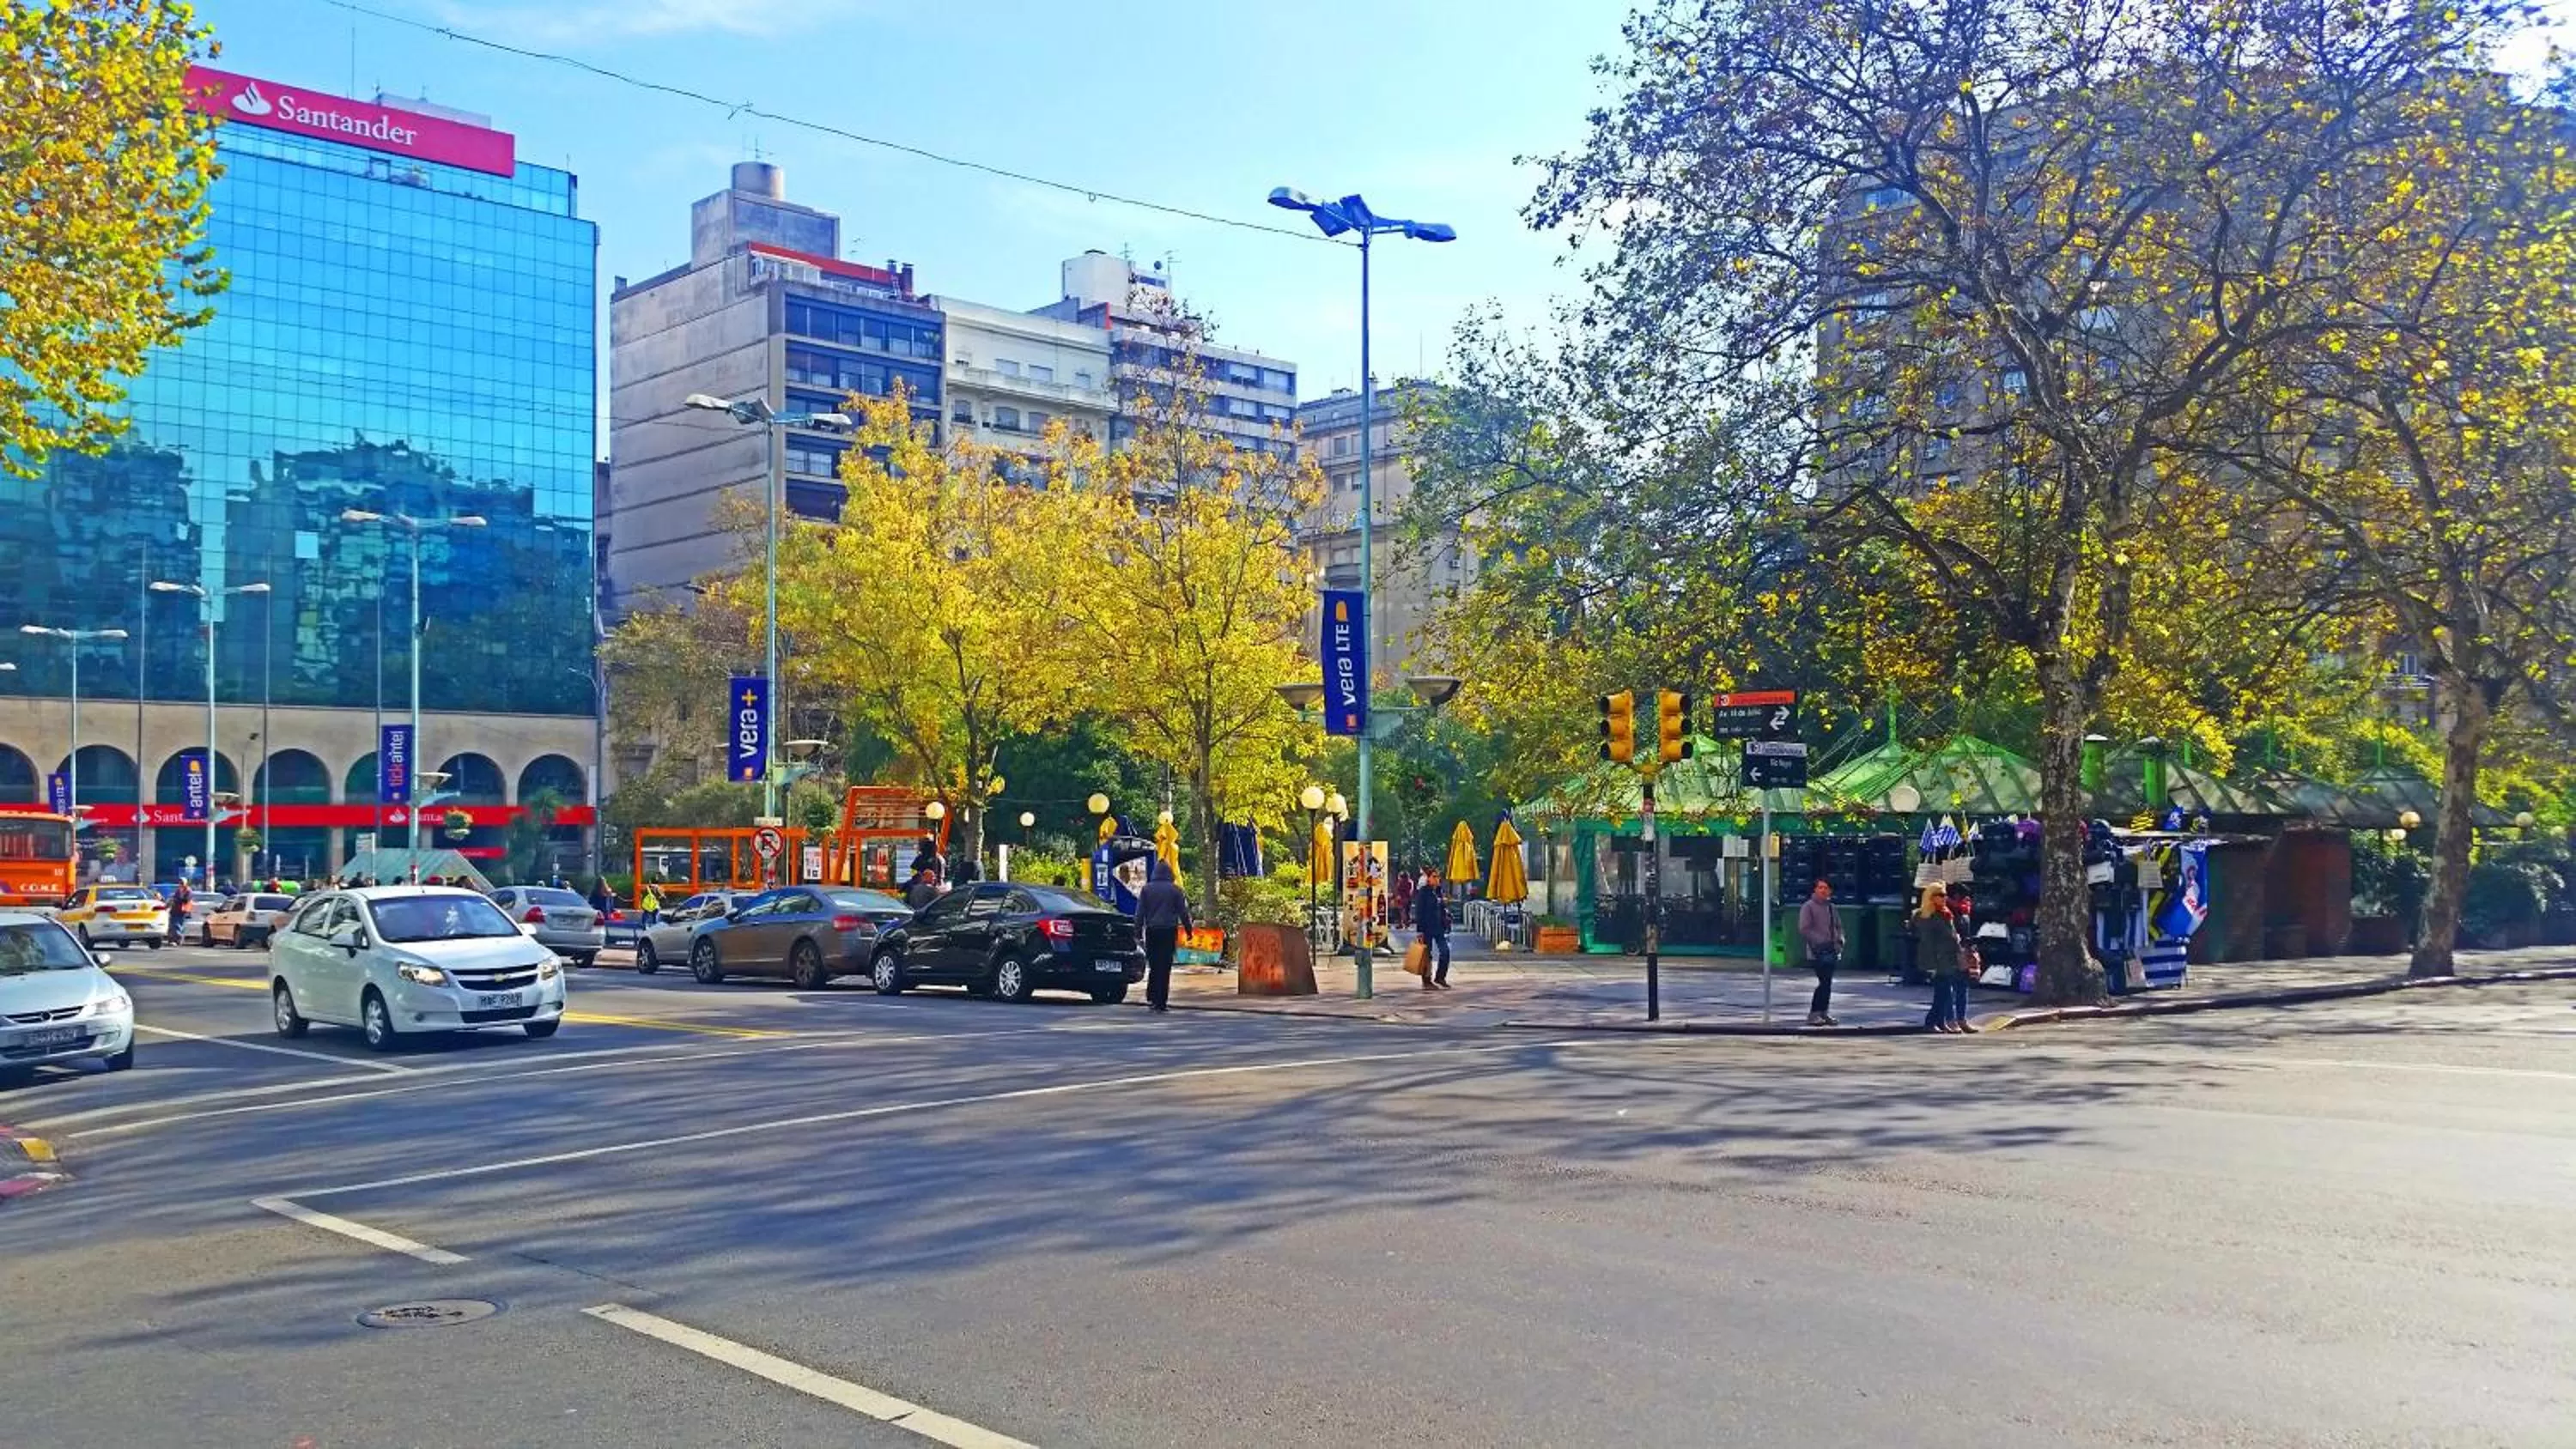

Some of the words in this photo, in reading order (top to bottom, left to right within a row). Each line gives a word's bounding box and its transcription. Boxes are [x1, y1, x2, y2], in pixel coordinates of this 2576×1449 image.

[277, 95, 418, 146] Santander
[1335, 623, 1351, 652] LTE
[1338, 657, 1358, 706] vera
[187, 773, 204, 808] antel
